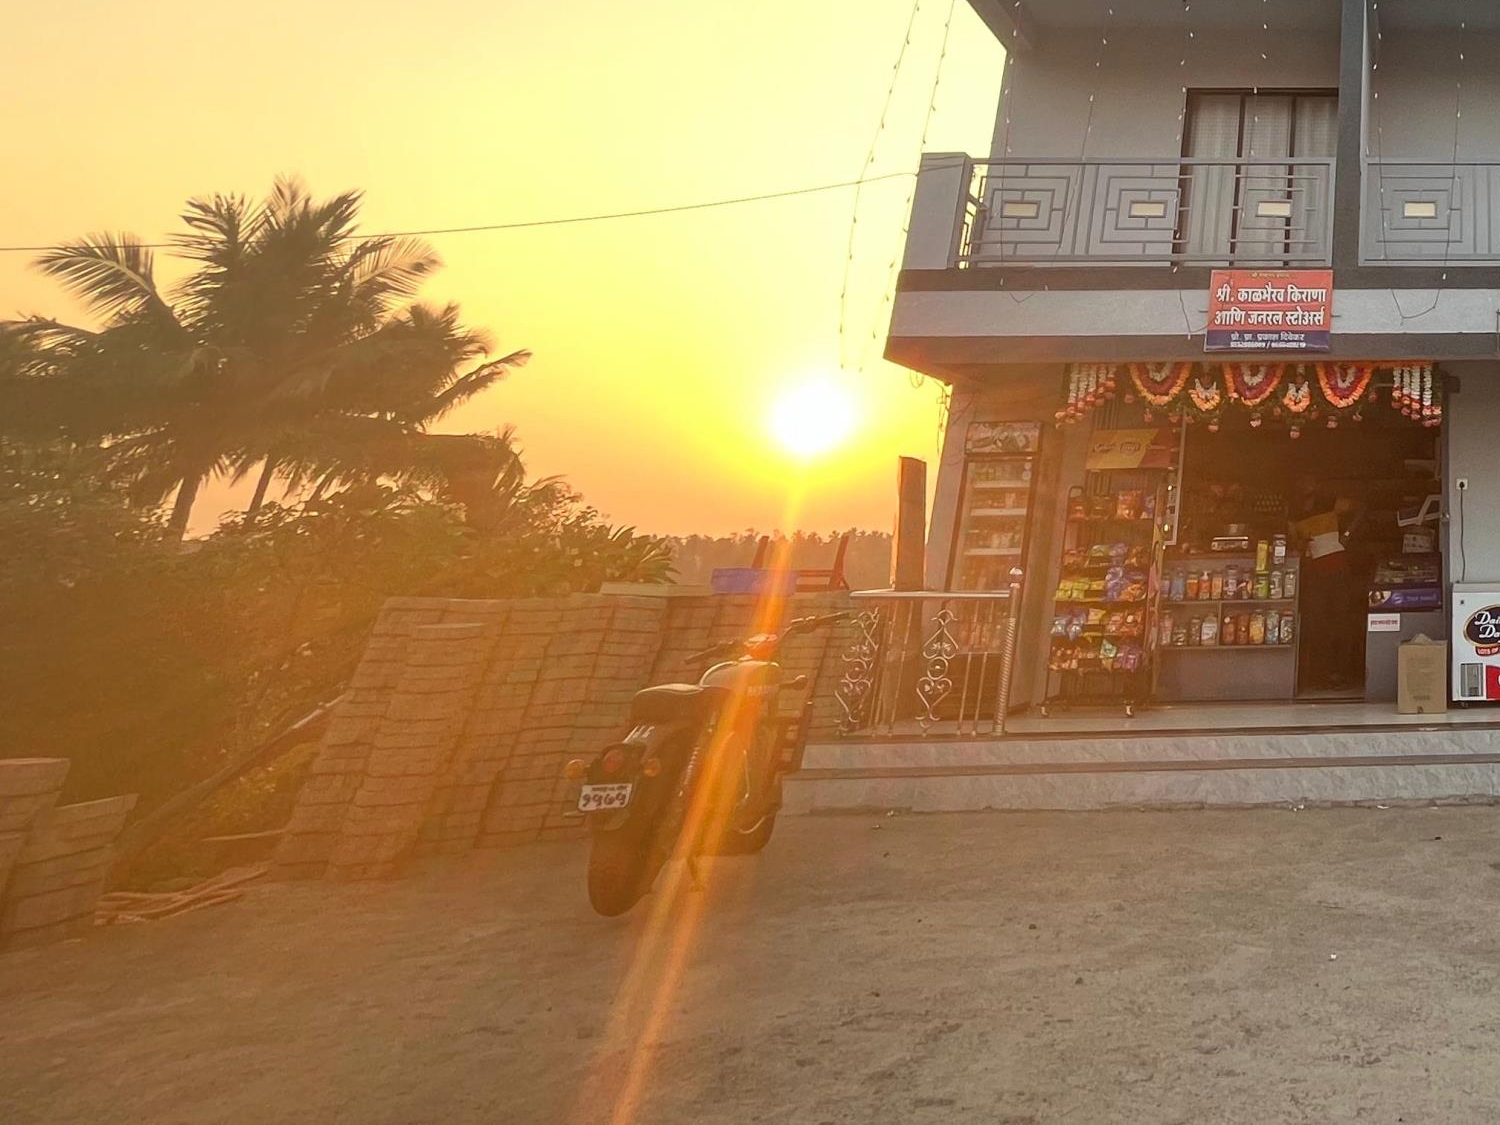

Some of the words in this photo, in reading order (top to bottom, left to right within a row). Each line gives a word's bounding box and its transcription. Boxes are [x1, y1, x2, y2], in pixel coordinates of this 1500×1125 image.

[1216, 284, 1235, 302] श्री.
[1238, 282, 1285, 303] काळभैरव
[1287, 284, 1327, 303] किराणा
[1215, 306, 1245, 325] आणि
[1248, 311, 1283, 325] जनरल
[1285, 306, 1325, 325] स्टोअर्स
